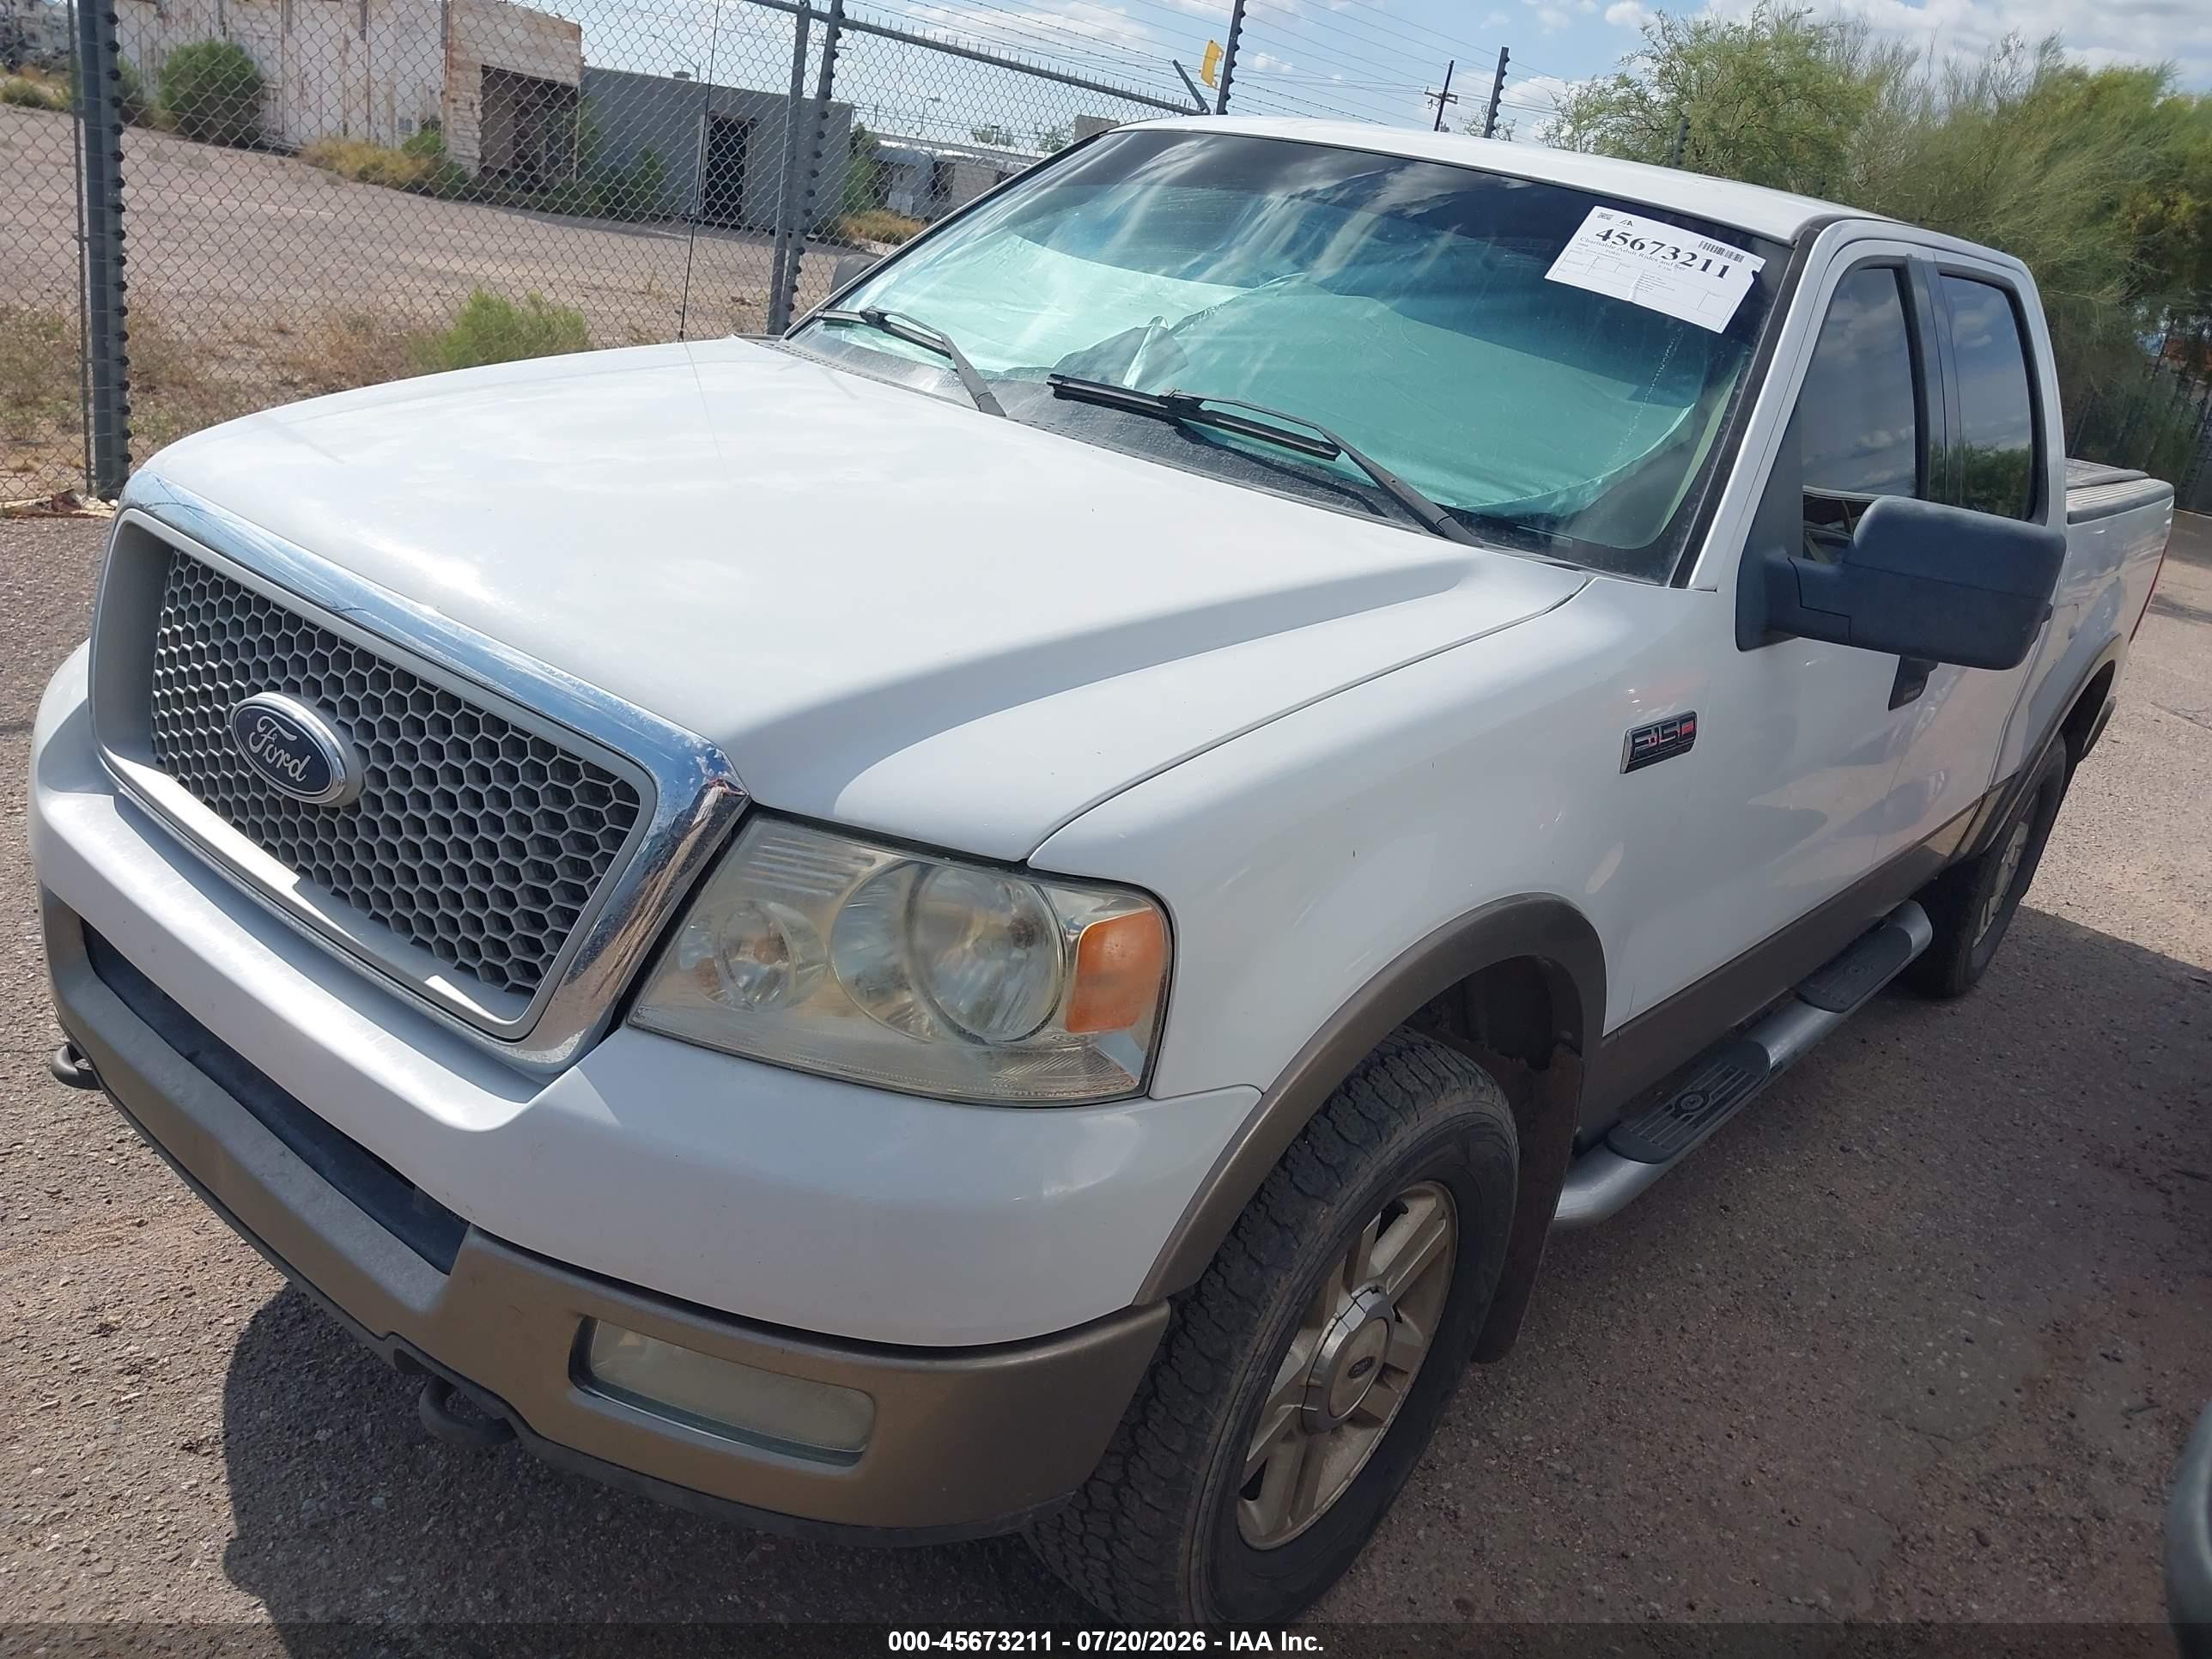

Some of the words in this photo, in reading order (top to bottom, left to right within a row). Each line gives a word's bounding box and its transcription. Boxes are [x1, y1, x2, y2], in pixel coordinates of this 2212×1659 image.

[1579, 236, 1615, 250] Charitable
[1617, 246, 1637, 257] Adult
[1638, 252, 1657, 262] Rides
[1595, 228, 1730, 279] 45673211
[248, 715, 312, 782] Ford
